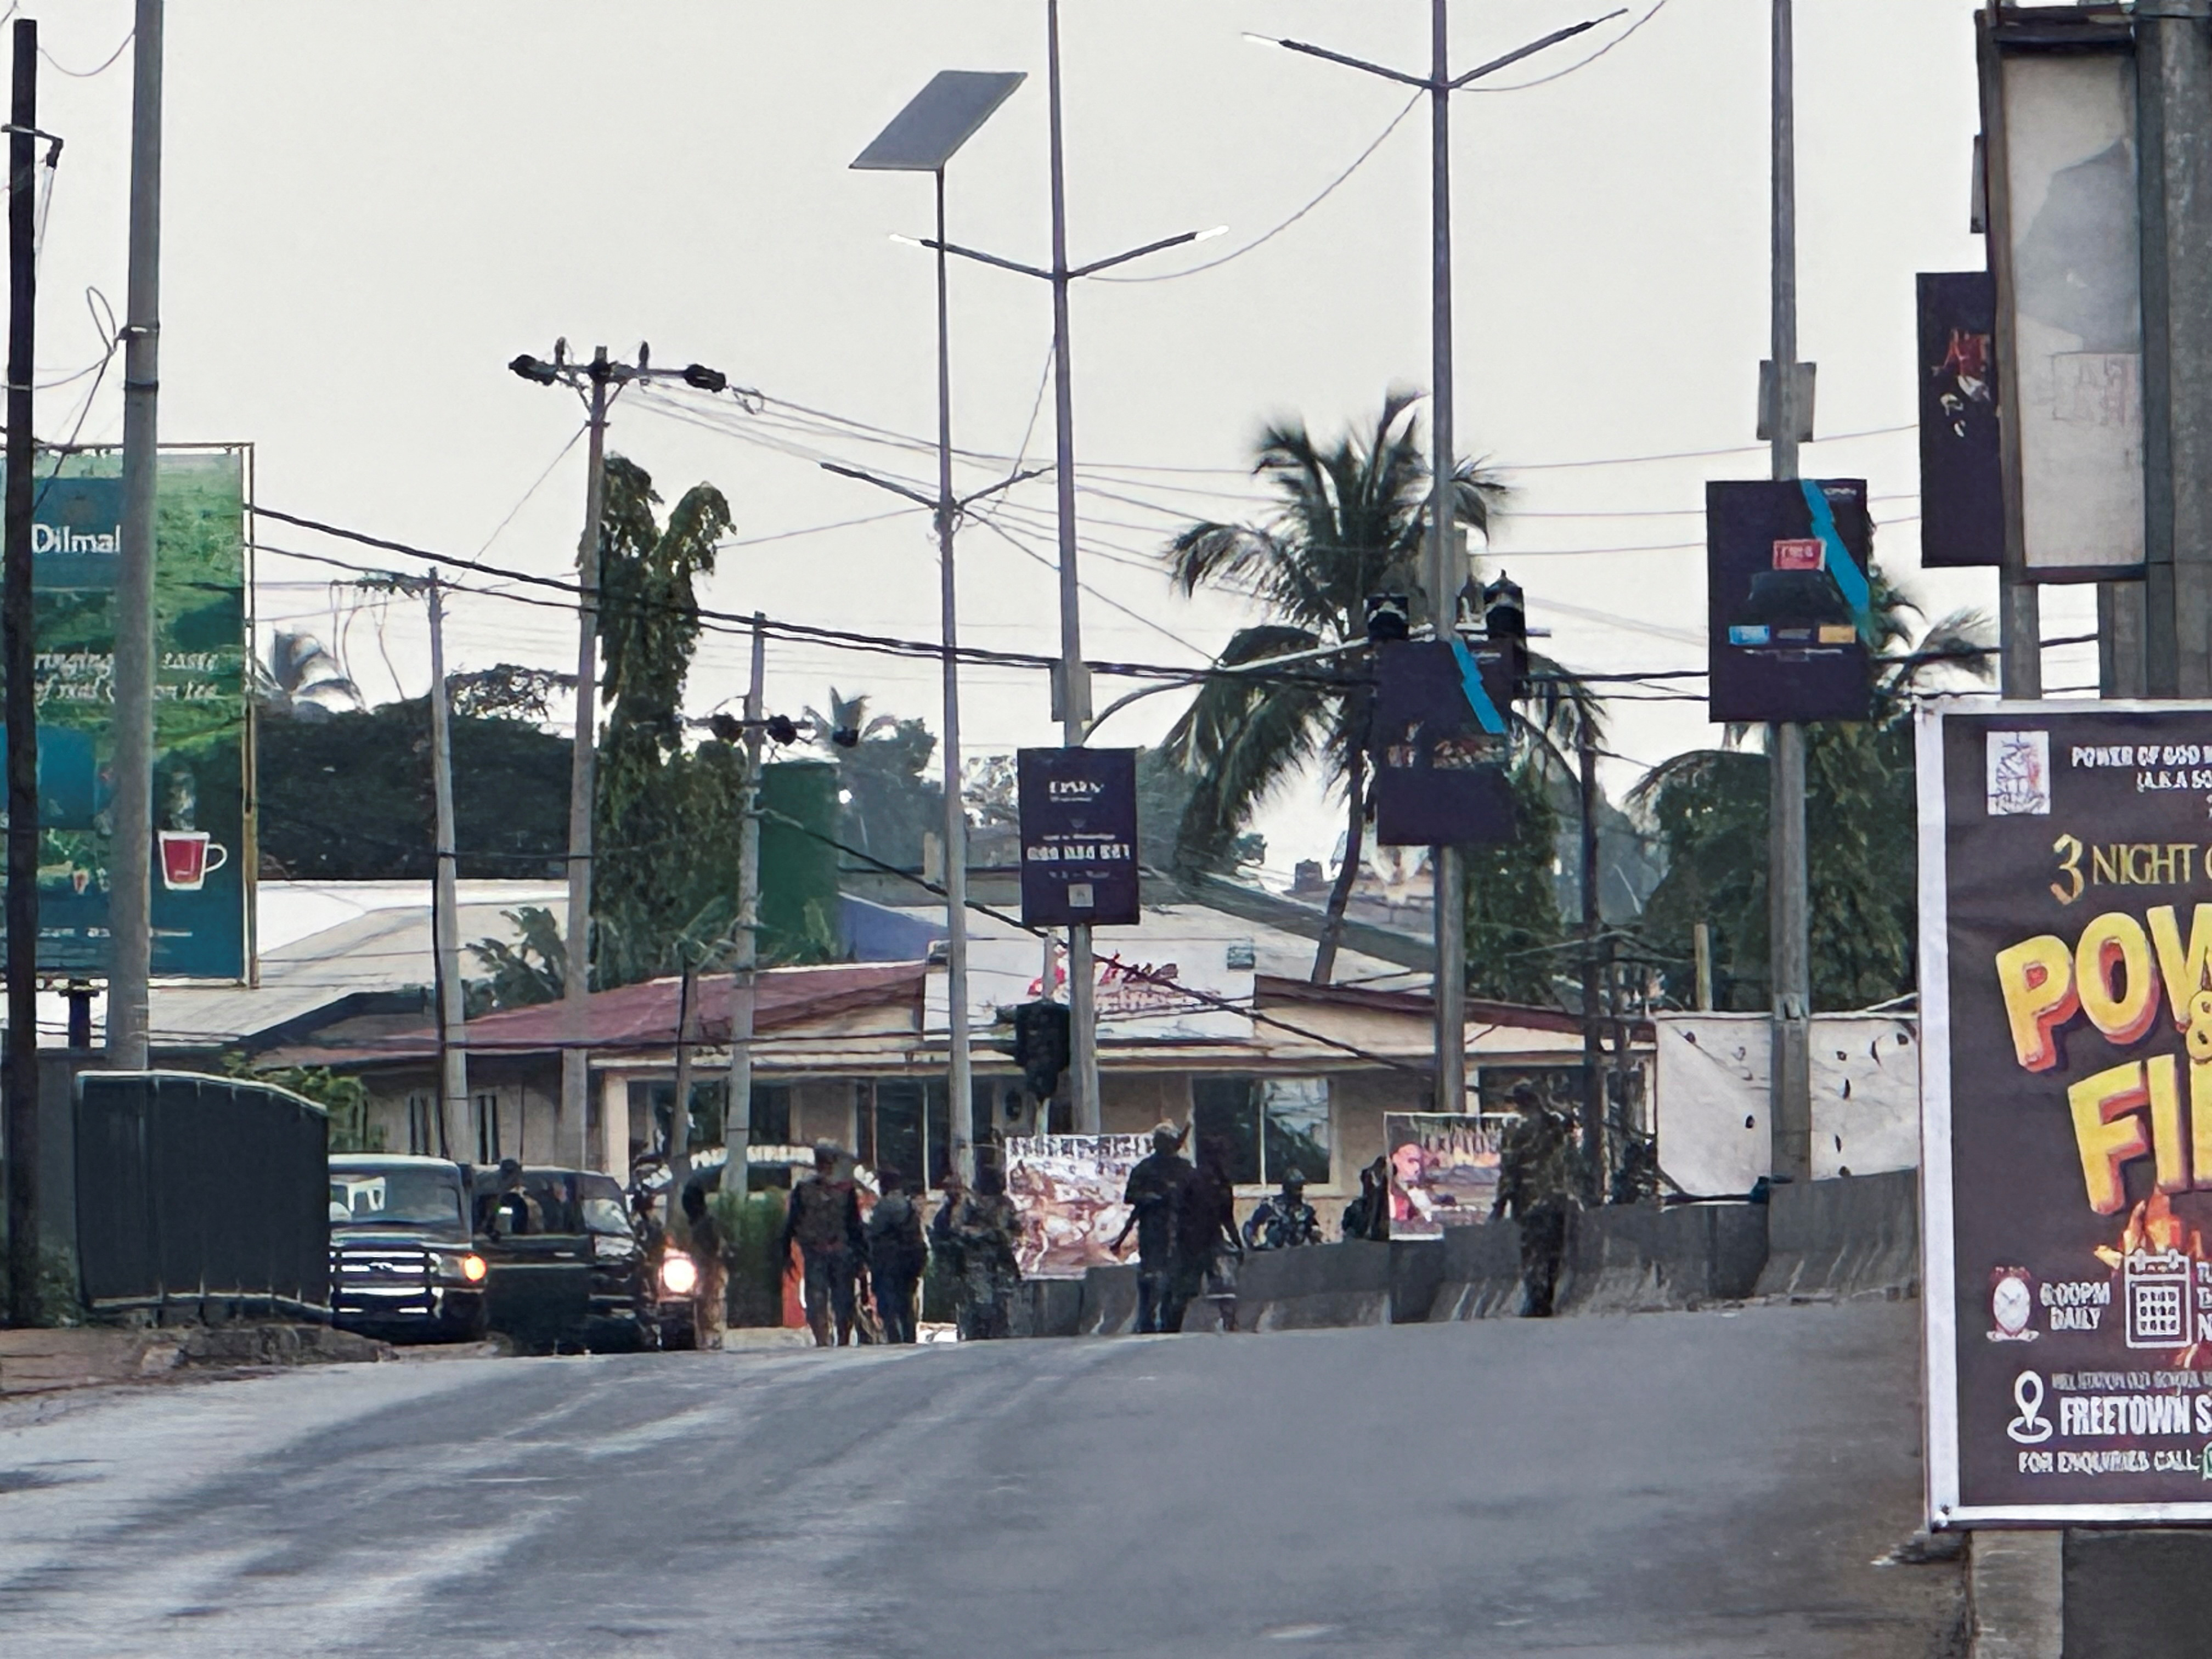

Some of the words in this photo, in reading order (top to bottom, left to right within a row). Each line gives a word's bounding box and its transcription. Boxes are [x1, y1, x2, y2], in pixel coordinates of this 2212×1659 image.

[2137, 746, 2160, 766] OF
[2050, 833, 2084, 905] 3
[2092, 844, 2198, 885] NIGHT
[1996, 903, 2212, 1073] POW
[2050, 1306, 2101, 1330] DAILY
[2060, 1395, 2191, 1436] FREETOWN
[2195, 1394, 2212, 1435] S
[2018, 1451, 2053, 1472] FOR
[2057, 1450, 2150, 1476] ENQUIRIES
